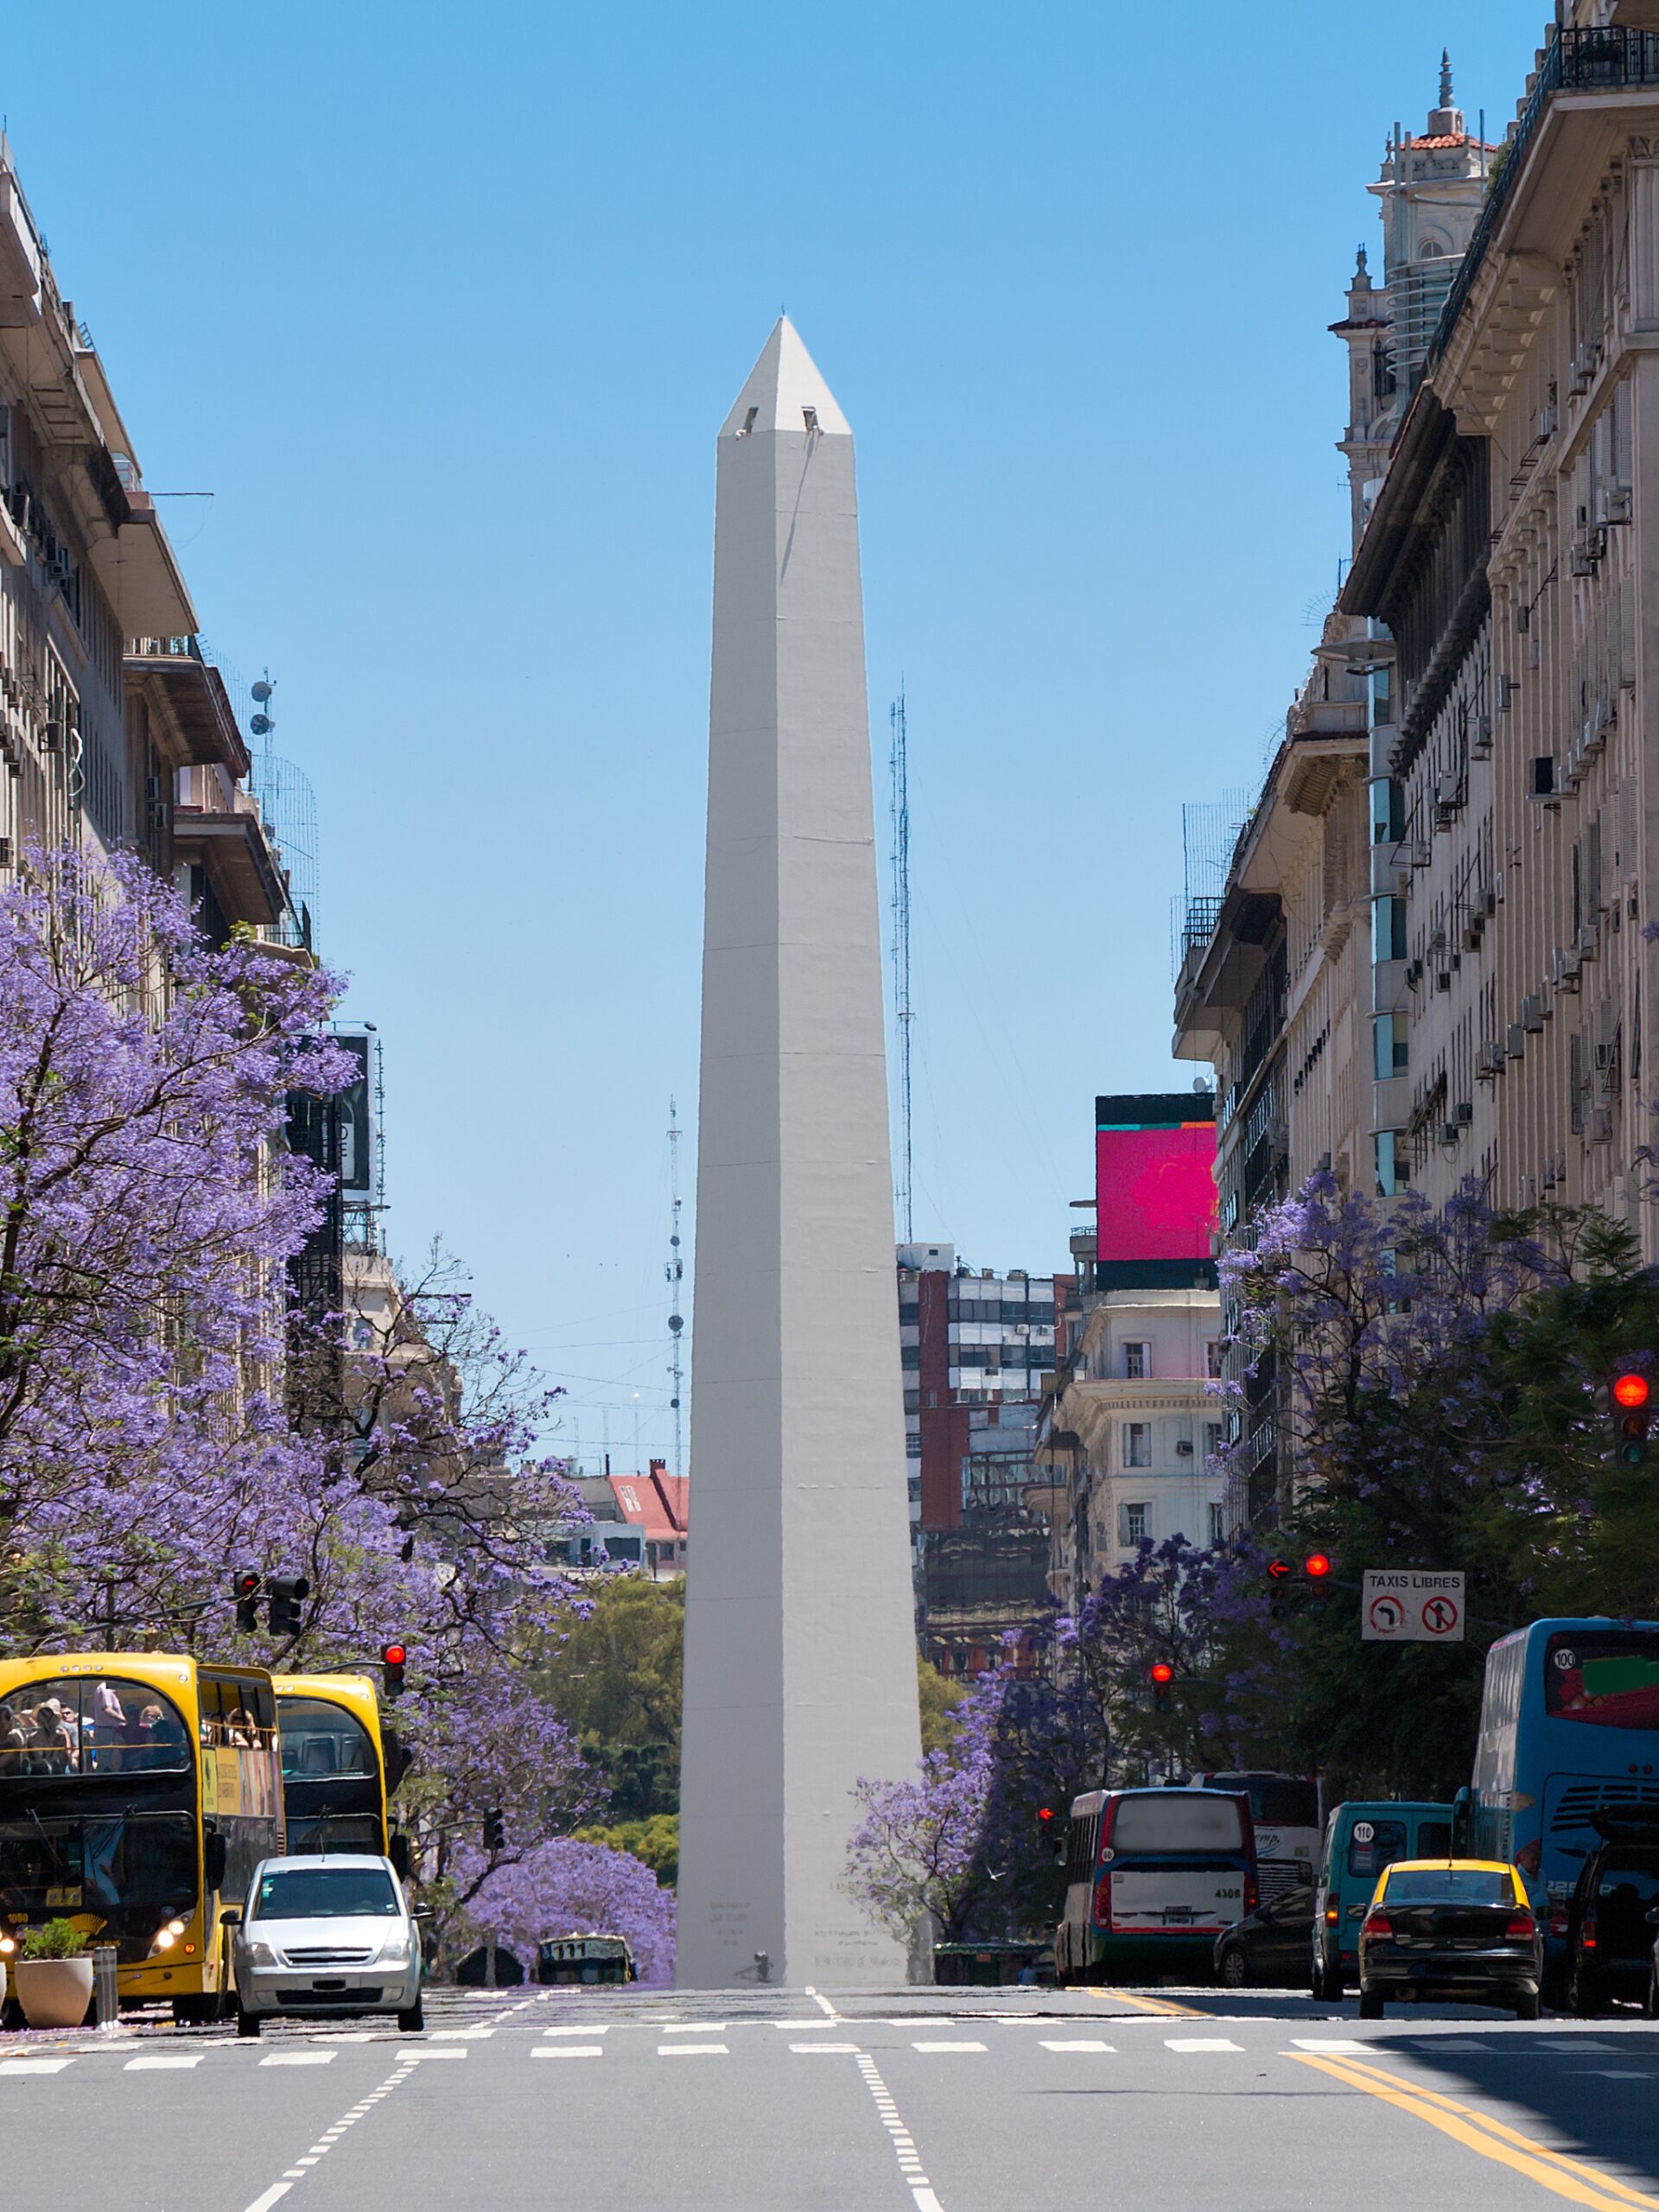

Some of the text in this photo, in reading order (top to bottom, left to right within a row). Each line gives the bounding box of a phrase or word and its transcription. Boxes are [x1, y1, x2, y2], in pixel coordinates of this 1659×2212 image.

[1370, 1575, 1460, 1588] TAXIS LIBRES
[1557, 1653, 1574, 1666] 100
[1357, 1826, 1372, 1839] 110
